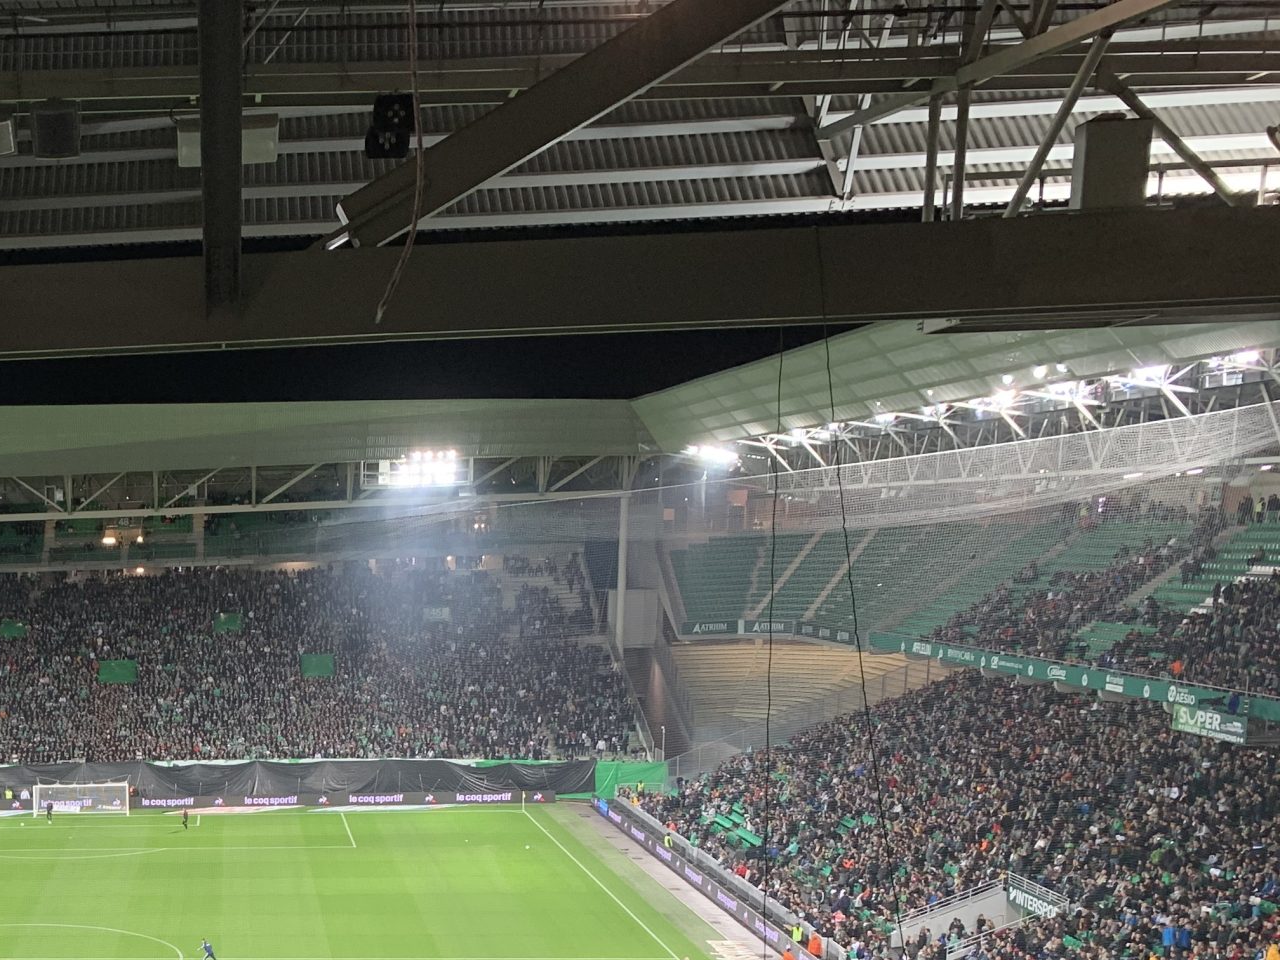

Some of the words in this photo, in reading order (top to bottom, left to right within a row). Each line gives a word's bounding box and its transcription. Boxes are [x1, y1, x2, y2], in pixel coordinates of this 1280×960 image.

[1178, 706, 1221, 731] SUPER
[142, 799, 150, 808] le
[150, 800, 165, 808] coq
[165, 797, 194, 808] sportif
[244, 796, 252, 805] le
[253, 798, 269, 806] coq
[269, 795, 298, 806] sportif
[349, 794, 357, 803] le
[358, 796, 375, 804] coq
[375, 793, 403, 804] sportif
[456, 792, 464, 801] le
[465, 794, 482, 803] coq
[483, 791, 512, 803] sportif
